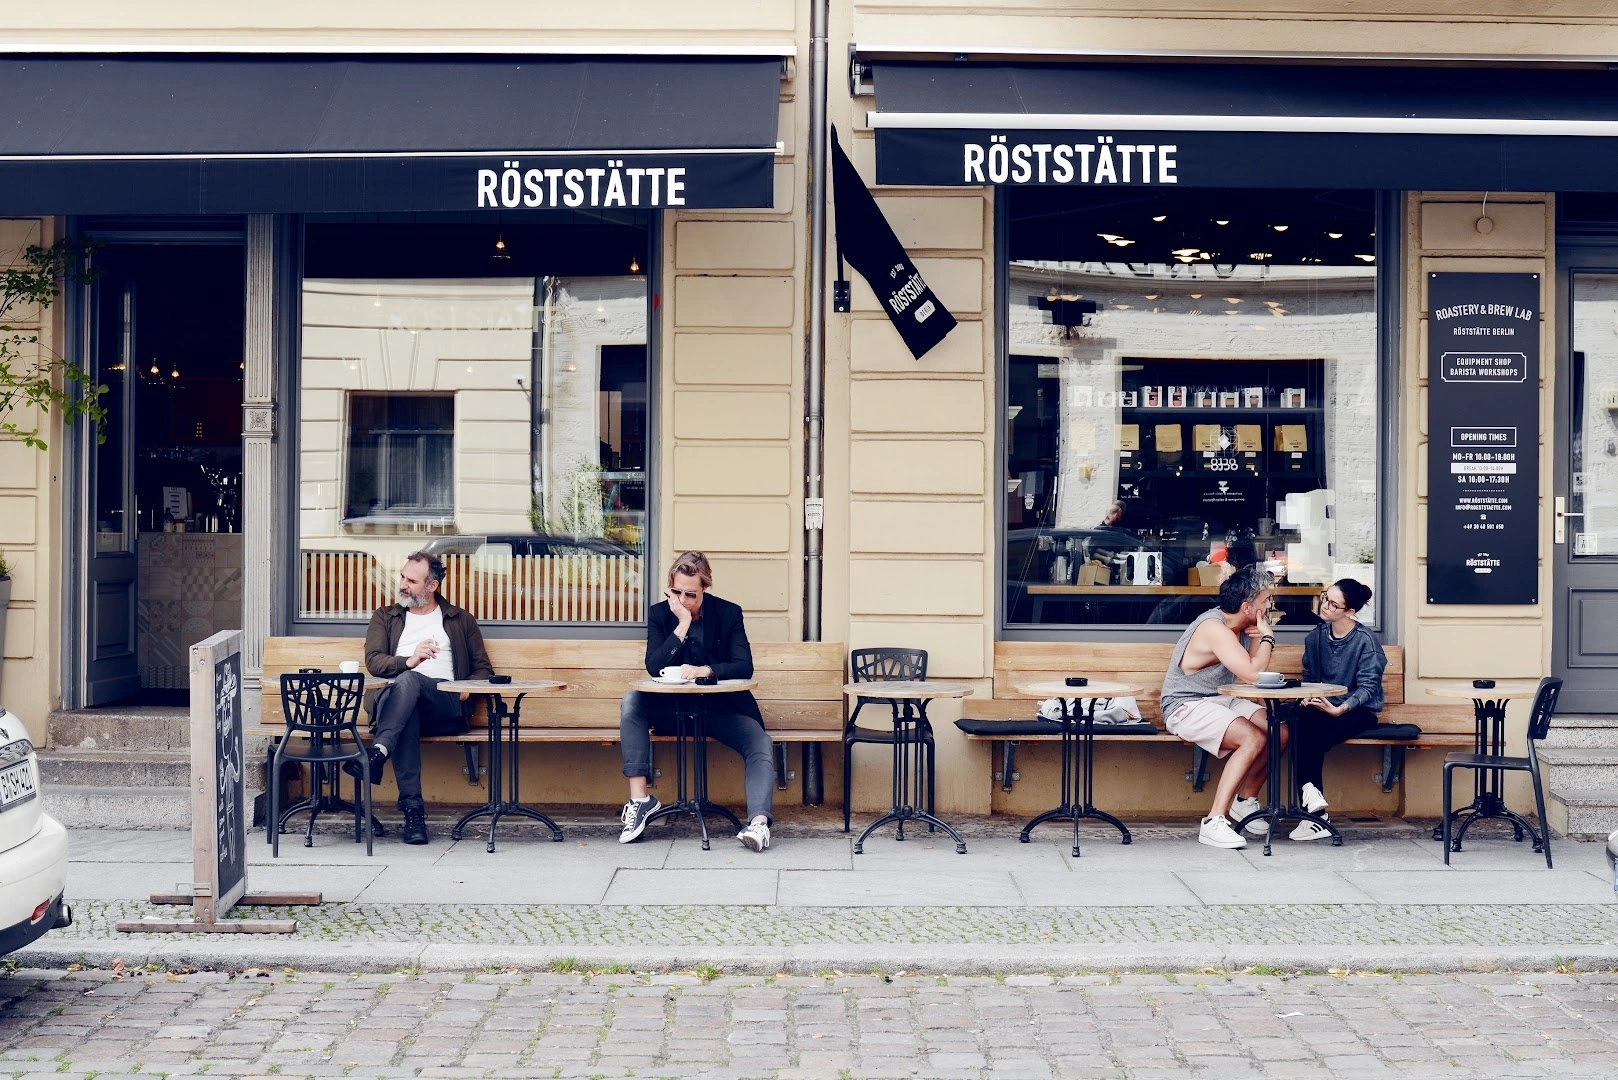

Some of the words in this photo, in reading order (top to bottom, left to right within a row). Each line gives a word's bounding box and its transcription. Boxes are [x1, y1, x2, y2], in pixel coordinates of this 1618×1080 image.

[965, 135, 1178, 184] RÖSTSTÄTTE
[477, 160, 686, 208] RÖSTSTÄTTE
[1435, 304, 1479, 321] ROASTERY
[1480, 304, 1487, 315] &
[1487, 303, 1514, 317] BREW
[1514, 307, 1533, 321] LAB
[1453, 326, 1491, 336] RÖSTSTÄTTE
[1492, 327, 1515, 336] BERLIN
[1456, 357, 1493, 366] EQUIPMENT
[1494, 357, 1512, 366] SHOP
[1450, 368, 1477, 376] BARISTA
[1478, 368, 1518, 377] WORKSHOPS
[1460, 433, 1487, 442] OPENING
[1488, 433, 1508, 442] TIMES
[1452, 453, 1474, 461] MO-FR
[1457, 475, 1467, 484] SA
[1465, 558, 1501, 567] RÖSTSTÄTTE
